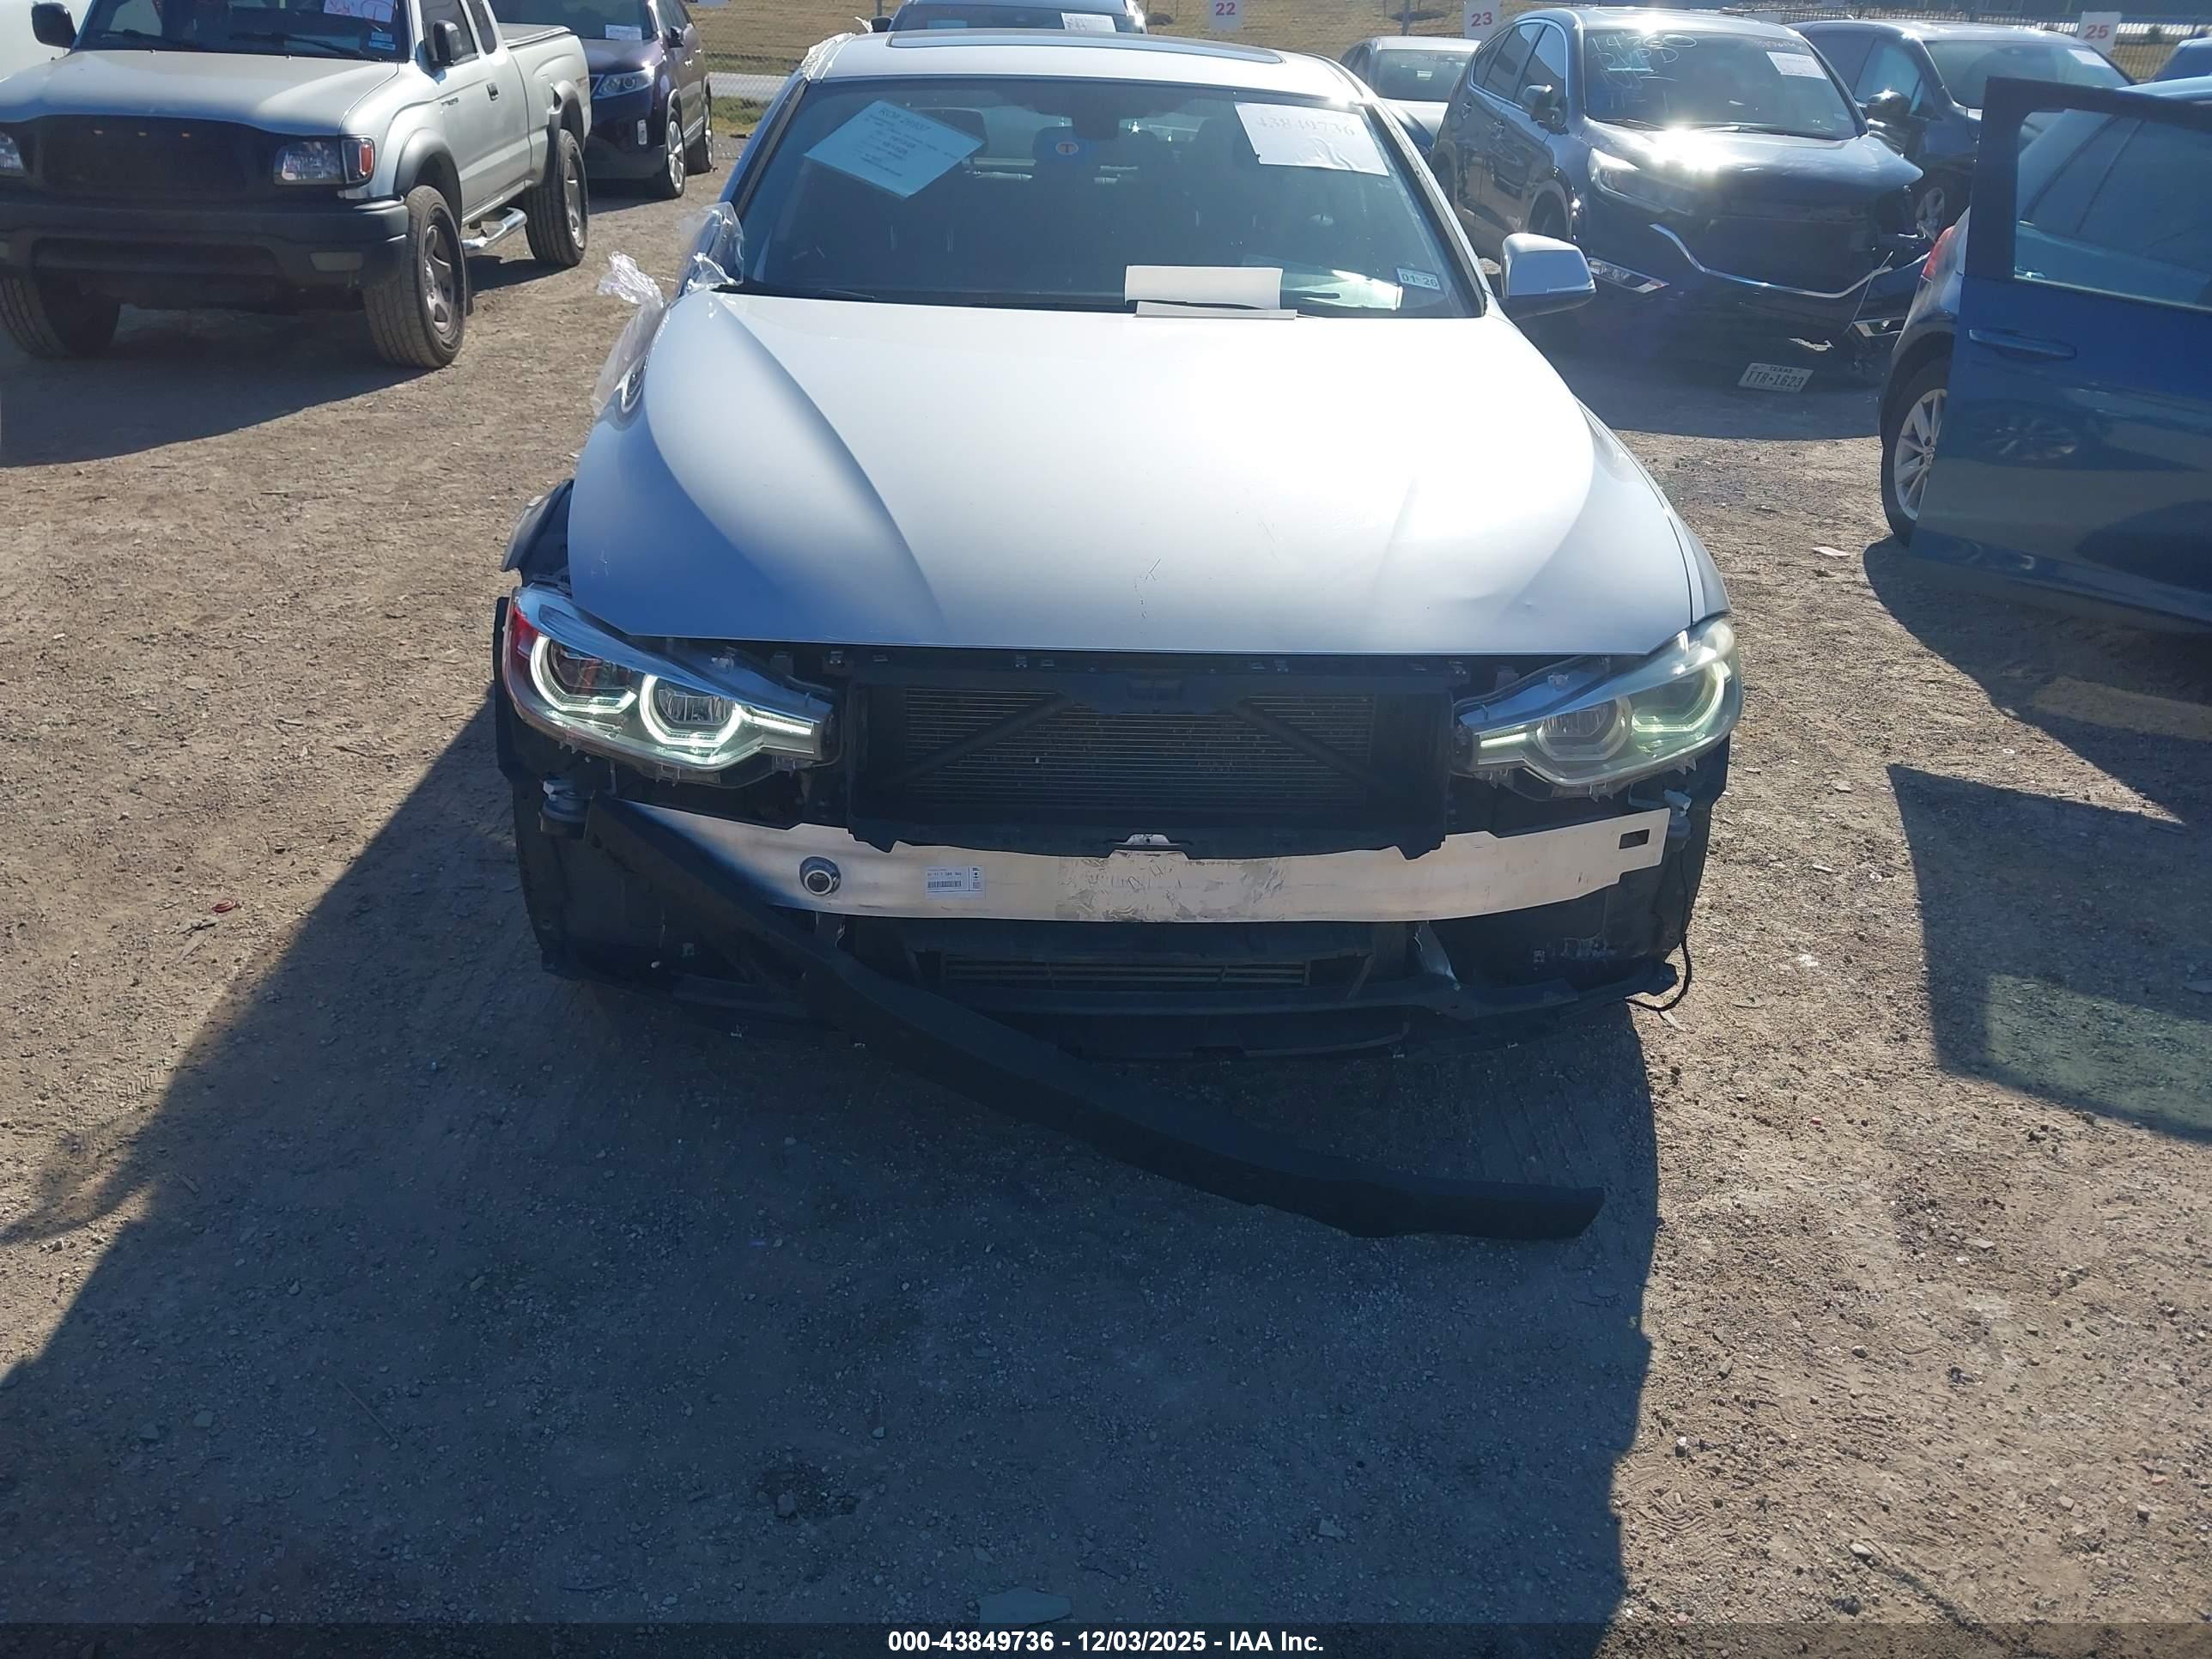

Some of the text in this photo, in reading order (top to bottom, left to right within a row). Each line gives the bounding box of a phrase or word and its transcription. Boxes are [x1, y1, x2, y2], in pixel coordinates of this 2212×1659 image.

[1215, 2, 1236, 15] 22
[1471, 11, 1493, 27] 23
[2084, 24, 2110, 40] 25
